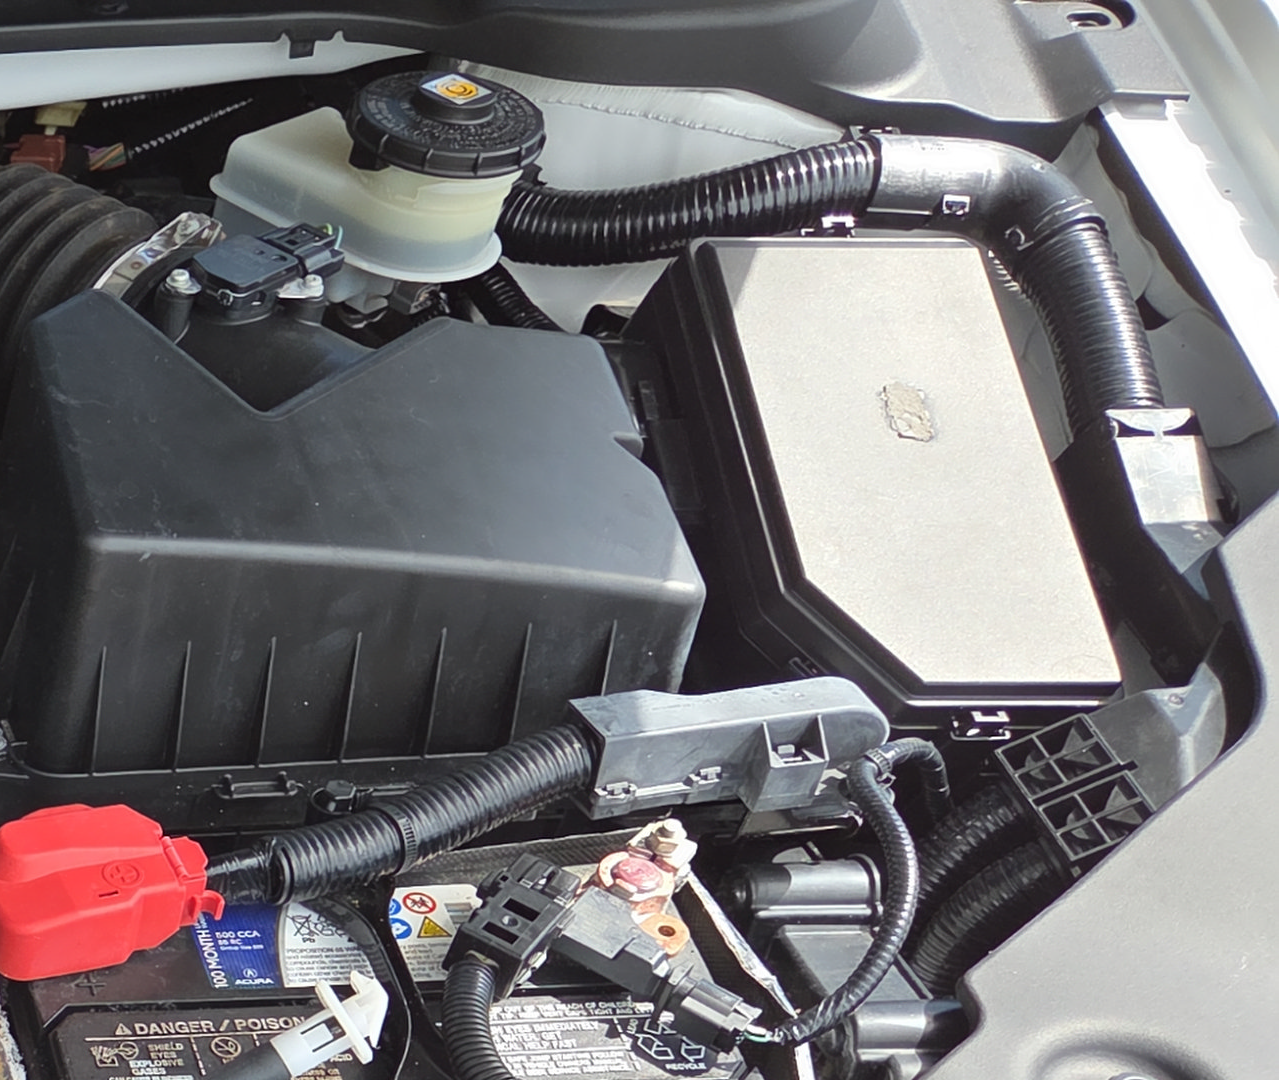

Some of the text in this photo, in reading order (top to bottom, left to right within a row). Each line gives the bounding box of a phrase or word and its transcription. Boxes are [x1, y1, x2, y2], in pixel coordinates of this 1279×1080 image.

[215, 929, 261, 939] 500 CCA
[301, 936, 316, 945] Pb
[196, 929, 222, 969] MONTH
[210, 970, 230, 989] 100
[234, 977, 275, 986] ACURA
[133, 1015, 306, 1035] DANGER / POISON
[533, 1021, 599, 1031] IMMEDIATELY
[541, 1031, 563, 1041] GET
[524, 1040, 550, 1050] HELP
[551, 1038, 578, 1049] FAST
[129, 1058, 185, 1068] EXPLOSIVE
[664, 1062, 707, 1071] RECYCLE
